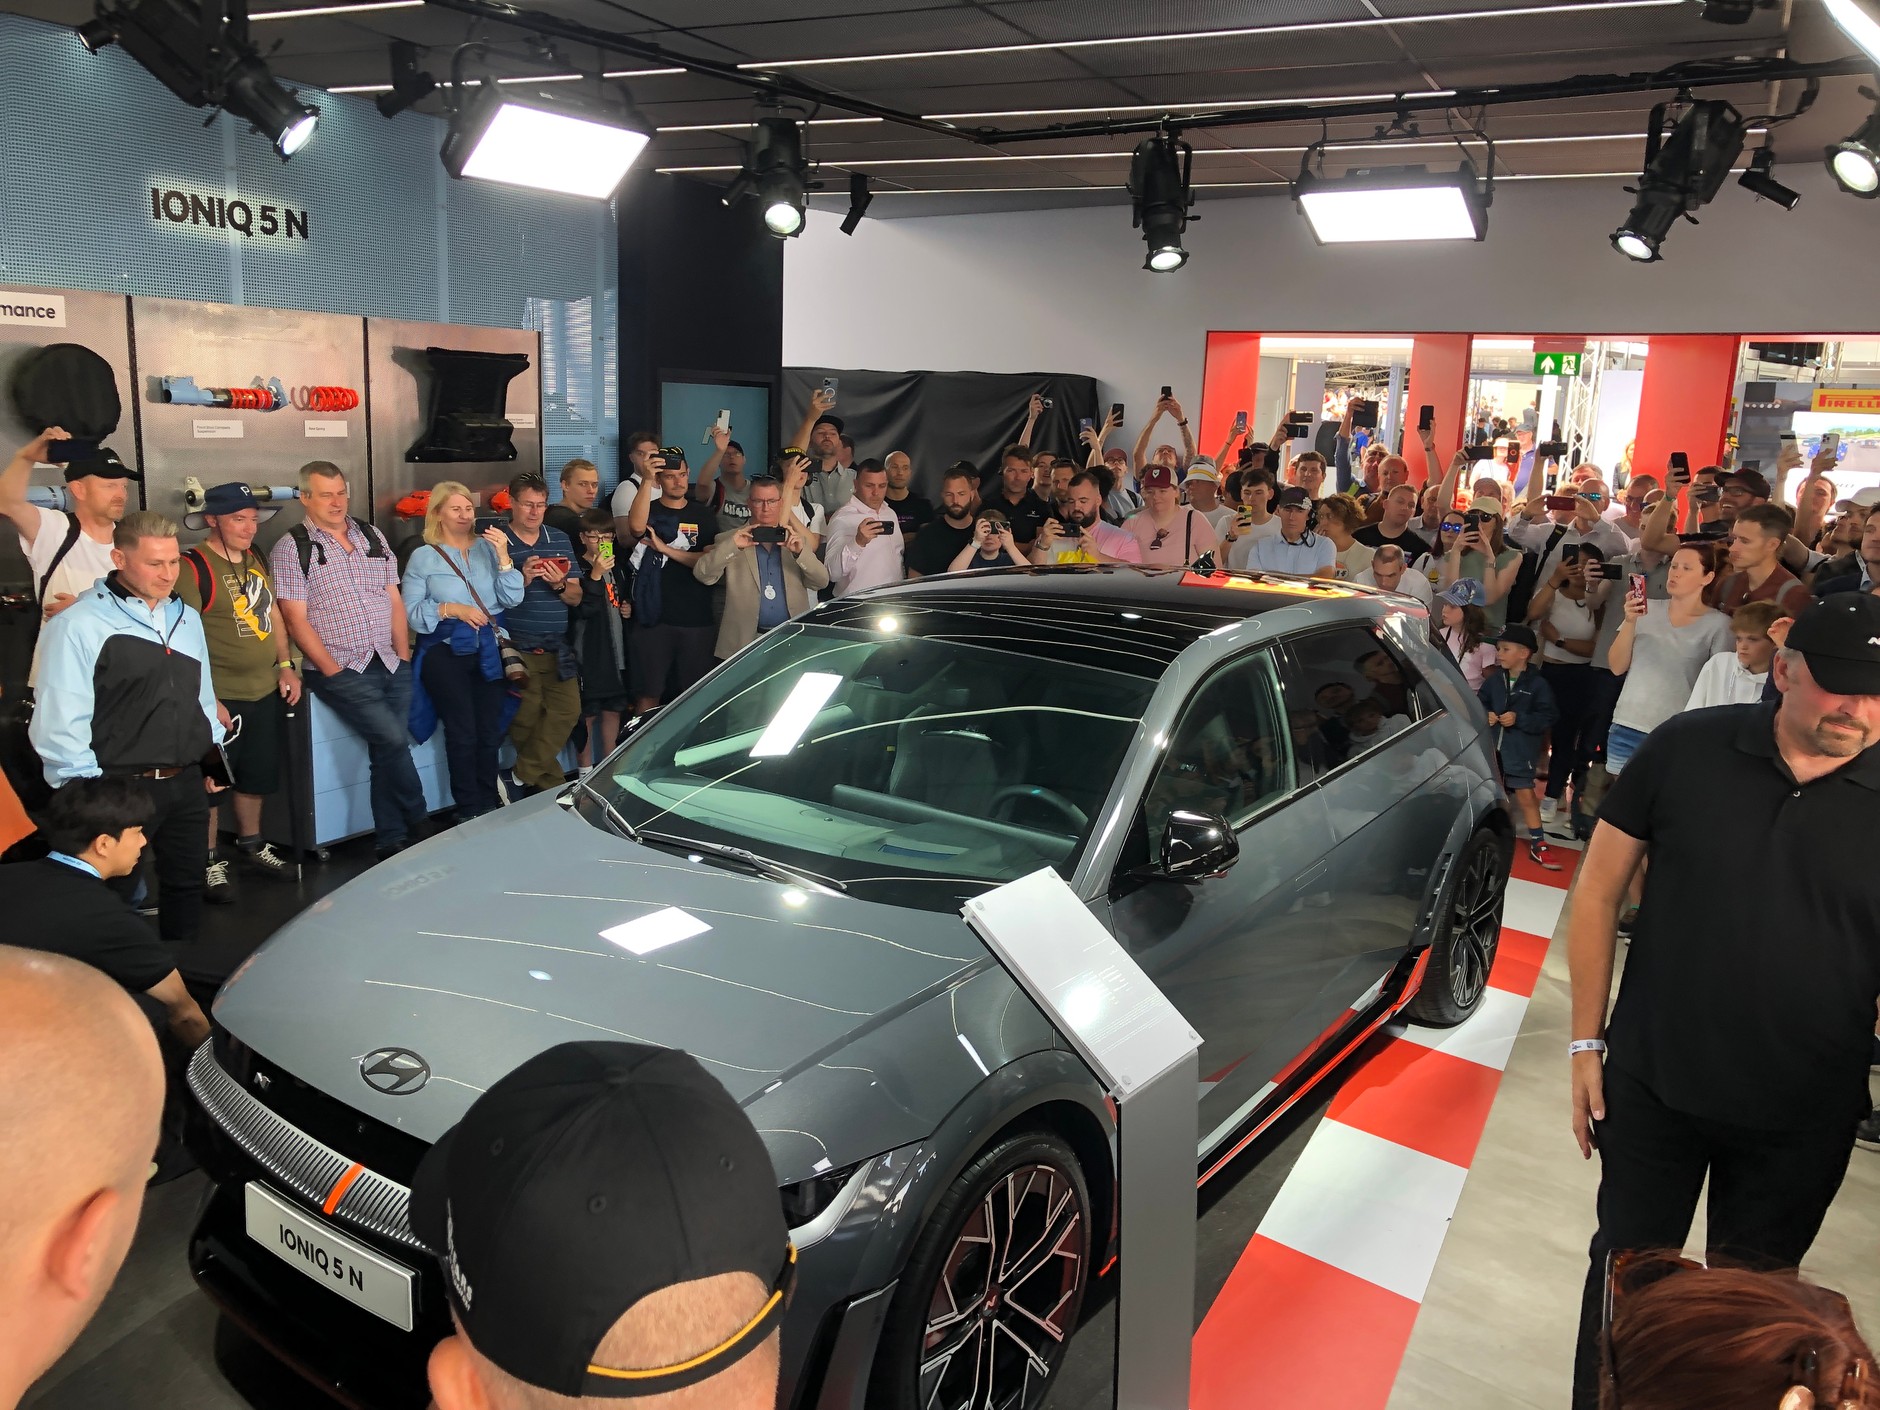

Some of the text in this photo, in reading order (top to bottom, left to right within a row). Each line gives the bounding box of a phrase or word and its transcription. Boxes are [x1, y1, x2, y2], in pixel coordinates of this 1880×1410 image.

[151, 187, 309, 239] IONIQ 5 N
[0, 304, 56, 319] mance
[279, 1223, 364, 1292] IONIQ 5 N
